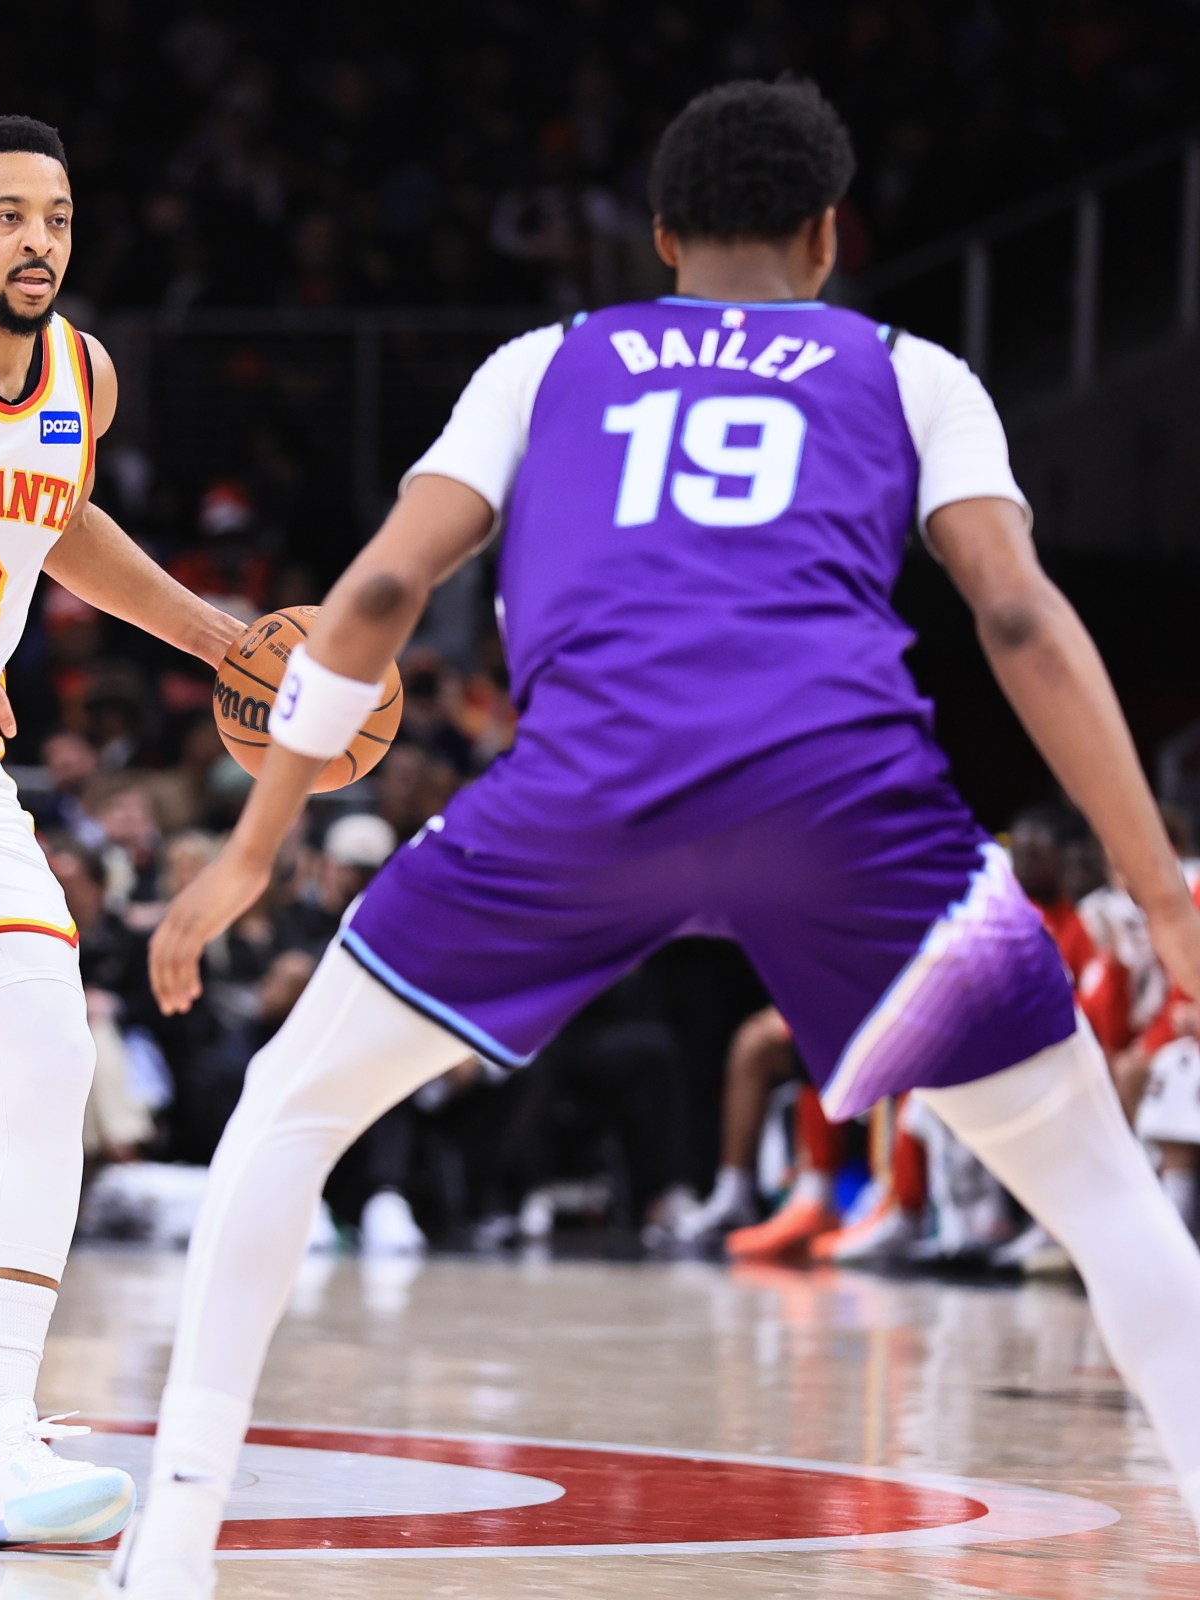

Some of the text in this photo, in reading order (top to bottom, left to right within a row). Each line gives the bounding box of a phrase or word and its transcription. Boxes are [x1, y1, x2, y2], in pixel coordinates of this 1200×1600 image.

[609, 327, 837, 383] BAILEY
[43, 419, 79, 437] paze
[602, 387, 808, 528] 19
